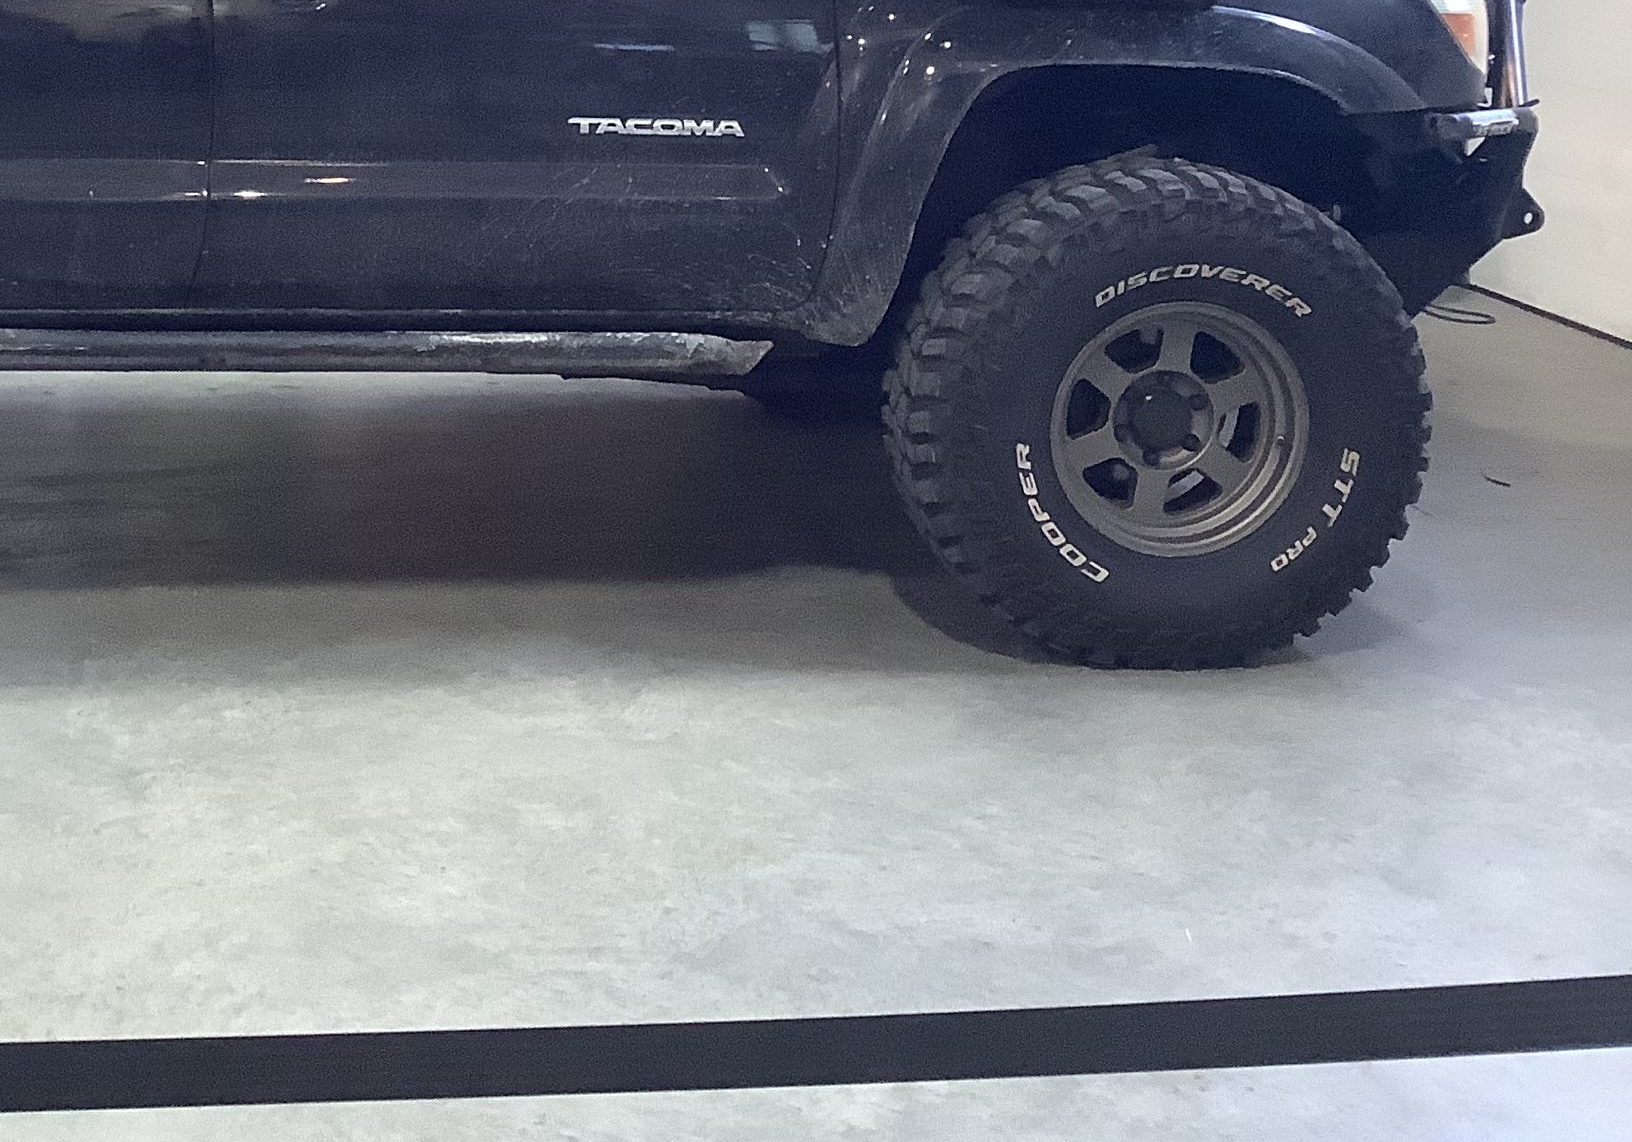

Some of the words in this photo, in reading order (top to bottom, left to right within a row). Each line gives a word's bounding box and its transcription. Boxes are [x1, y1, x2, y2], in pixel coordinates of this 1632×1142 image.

[567, 116, 746, 137] TACOMA
[1094, 263, 1313, 318] DISCOVERER
[1015, 442, 1111, 584] COOPER
[1320, 447, 1361, 528] STT
[1270, 525, 1318, 573] PRO
